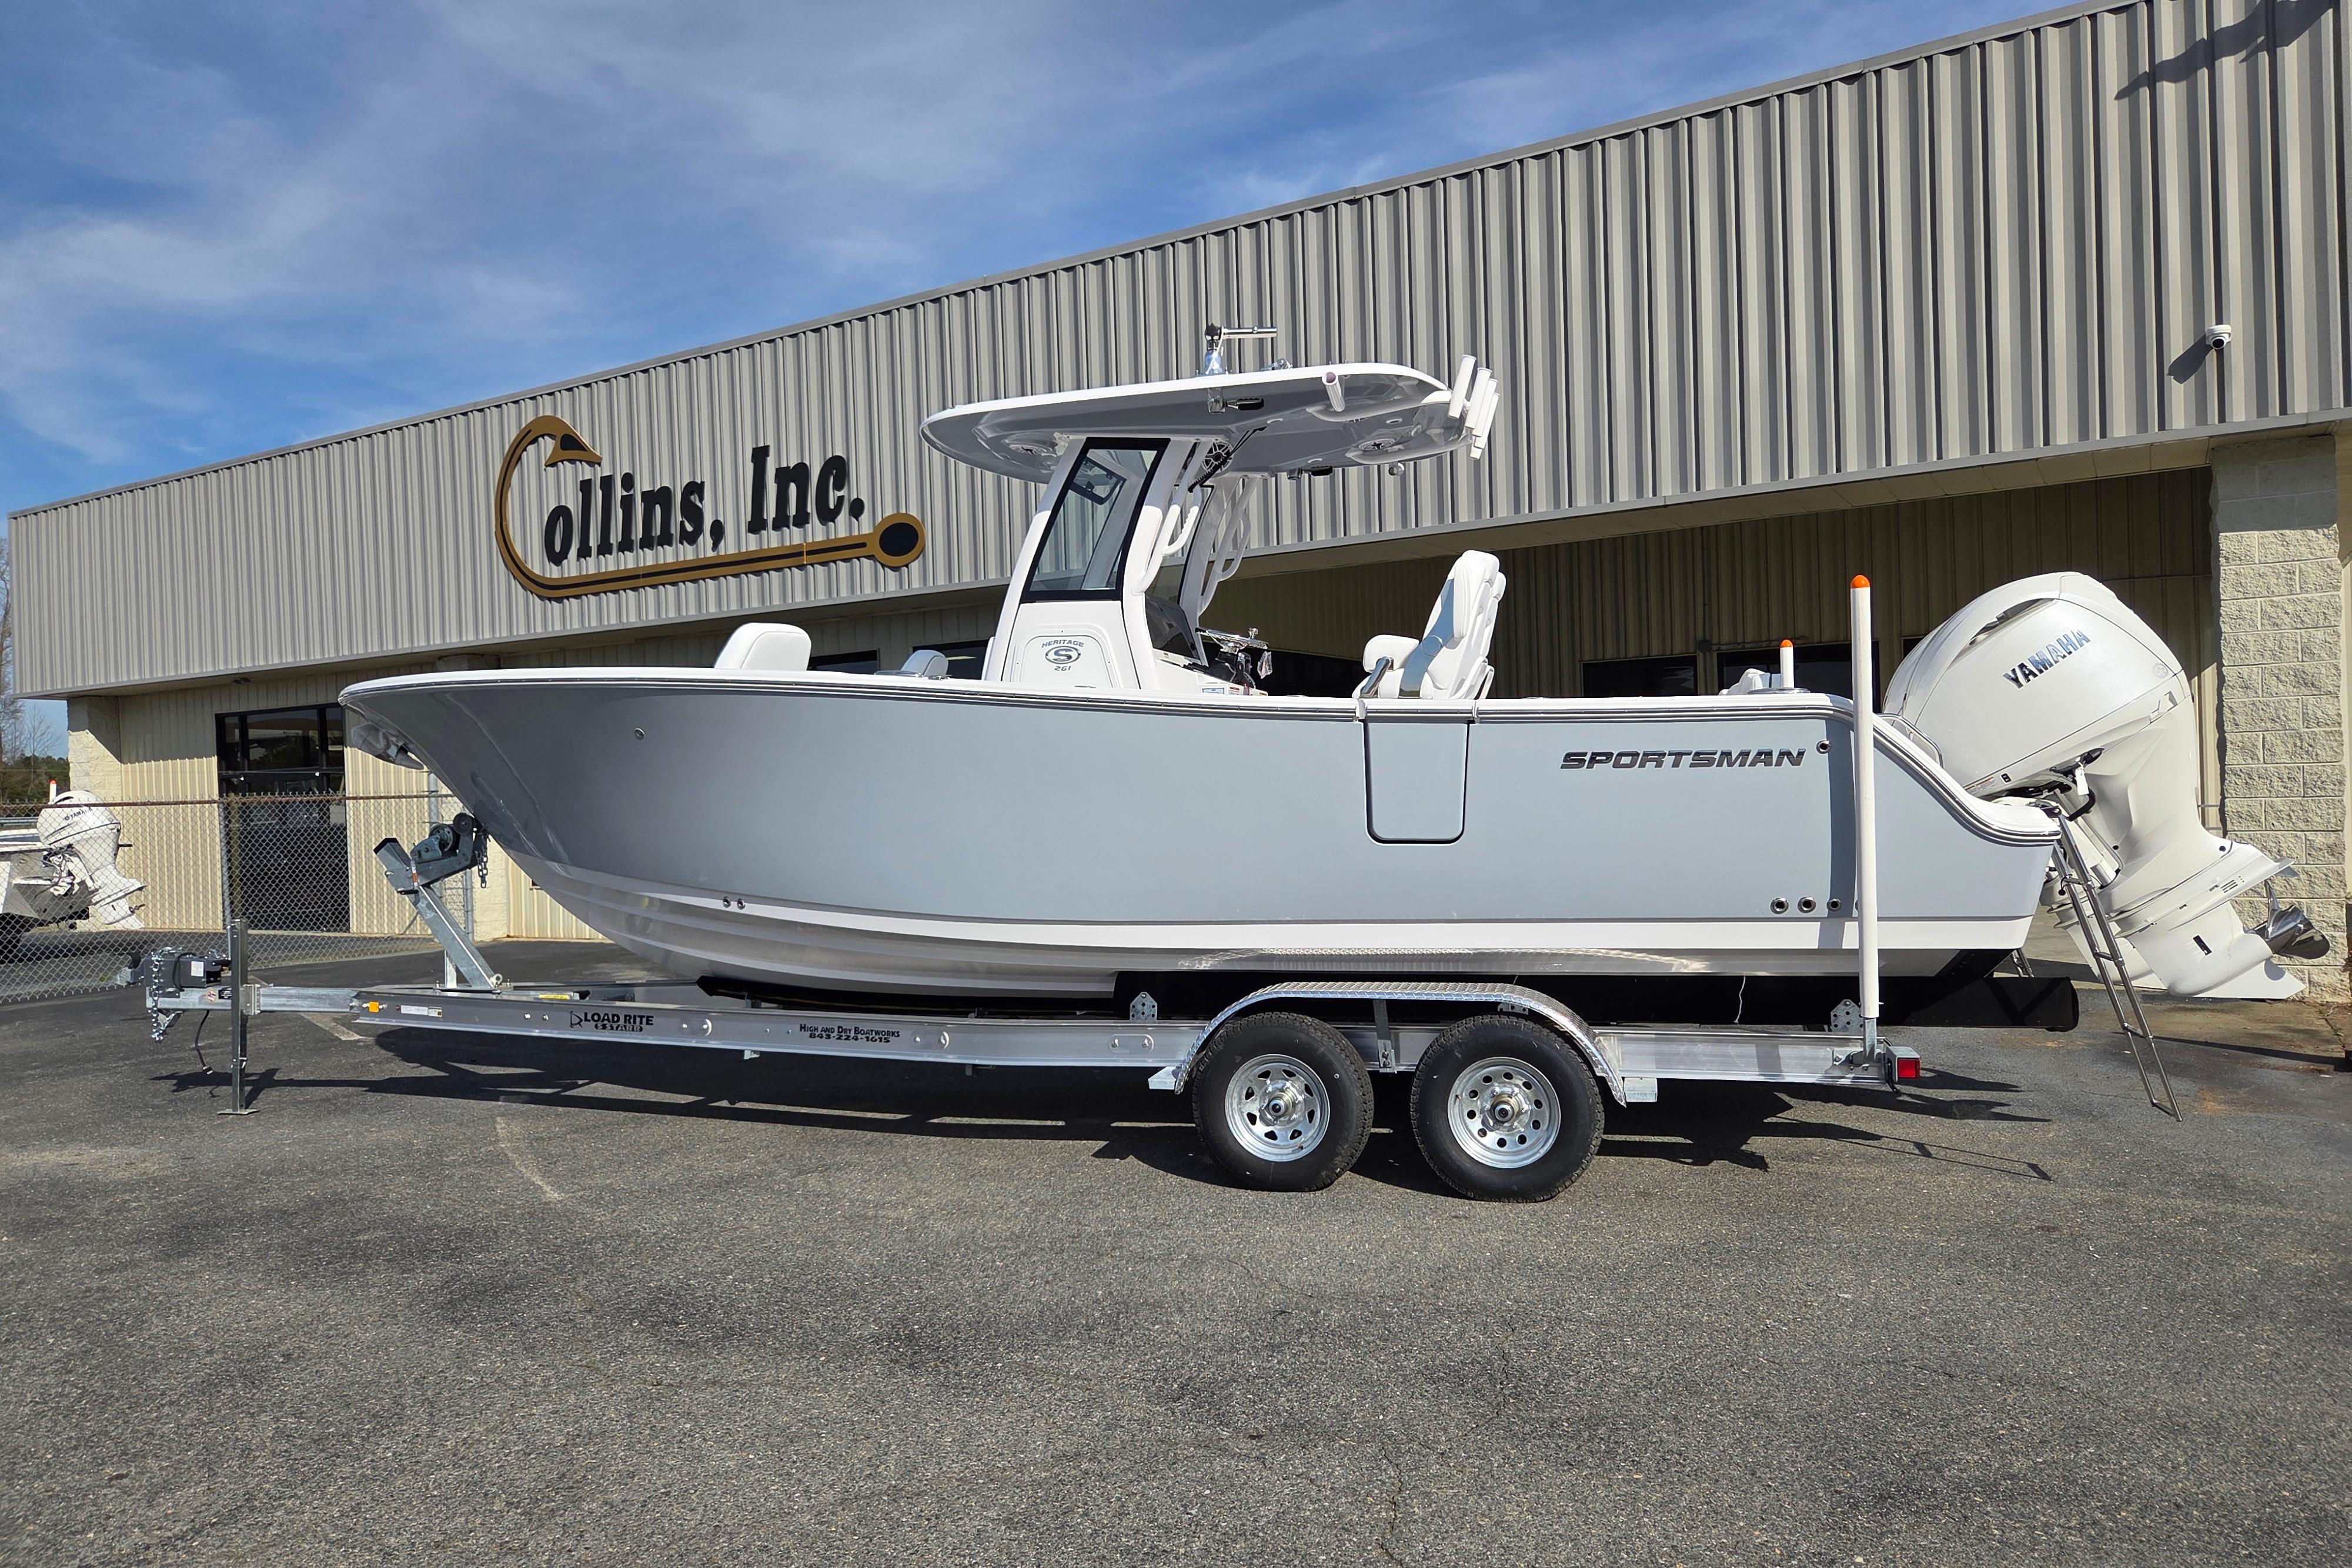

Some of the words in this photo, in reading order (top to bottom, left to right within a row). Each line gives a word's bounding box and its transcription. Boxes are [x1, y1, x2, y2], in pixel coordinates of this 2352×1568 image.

[747, 444, 865, 534] Inc.
[1041, 640, 1084, 648] HERITAGE
[2003, 628, 2092, 689] YAMAHA
[1560, 748, 1806, 769] SPORTSMAN
[584, 1012, 620, 1023] LOAD
[624, 1015, 654, 1025] RITE
[800, 1024, 819, 1033] HIGH
[837, 1025, 852, 1035] DRY
[808, 1033, 891, 1043] 843-224-1615
